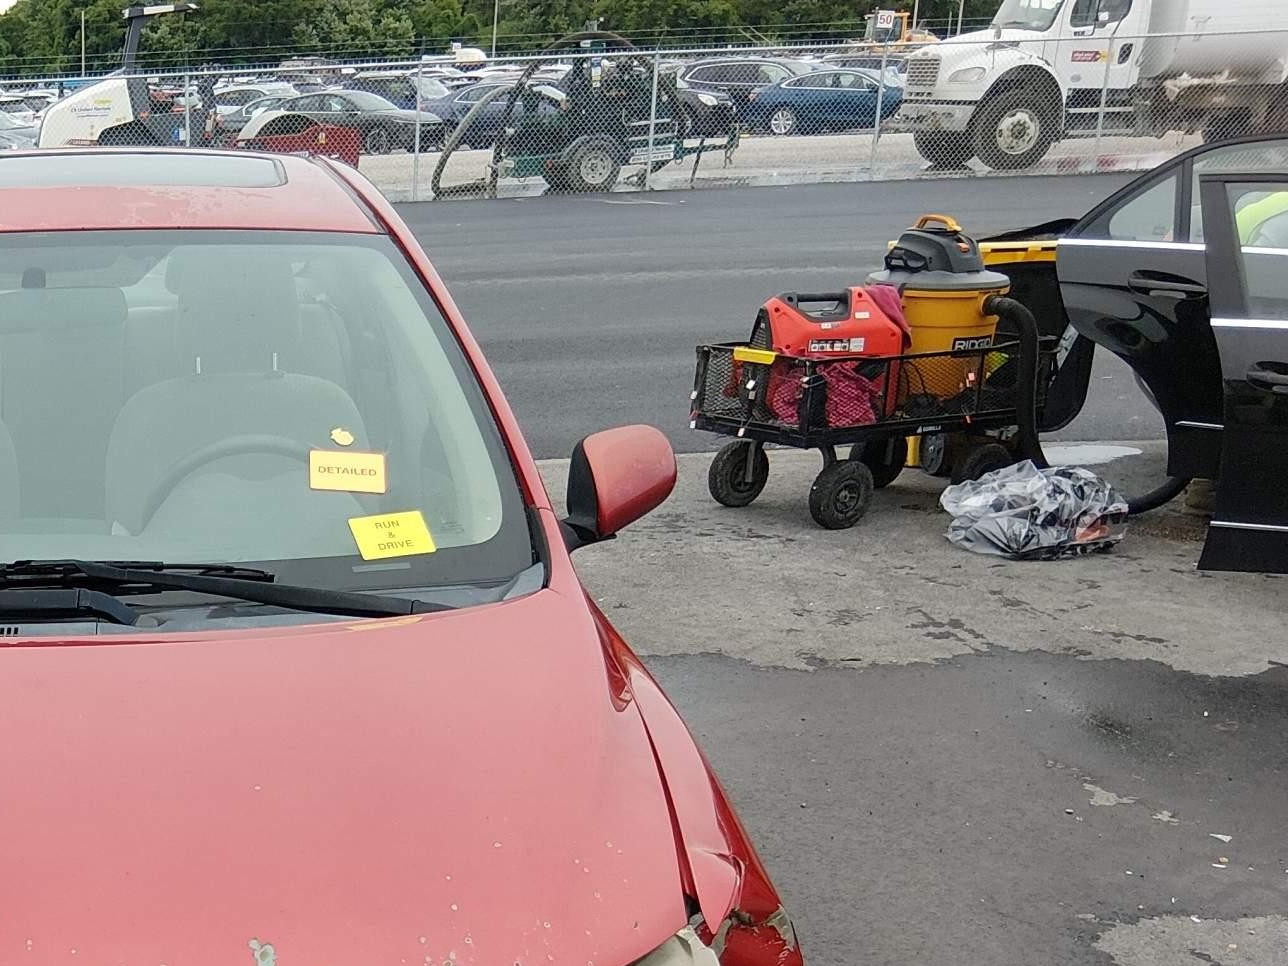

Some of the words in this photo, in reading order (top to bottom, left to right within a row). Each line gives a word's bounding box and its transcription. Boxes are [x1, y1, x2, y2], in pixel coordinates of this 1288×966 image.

[879, 15, 893, 25] 50
[318, 465, 377, 477] DETAILED
[375, 520, 400, 530] RUN
[388, 531, 396, 539] &
[378, 539, 415, 551] DRIVE
